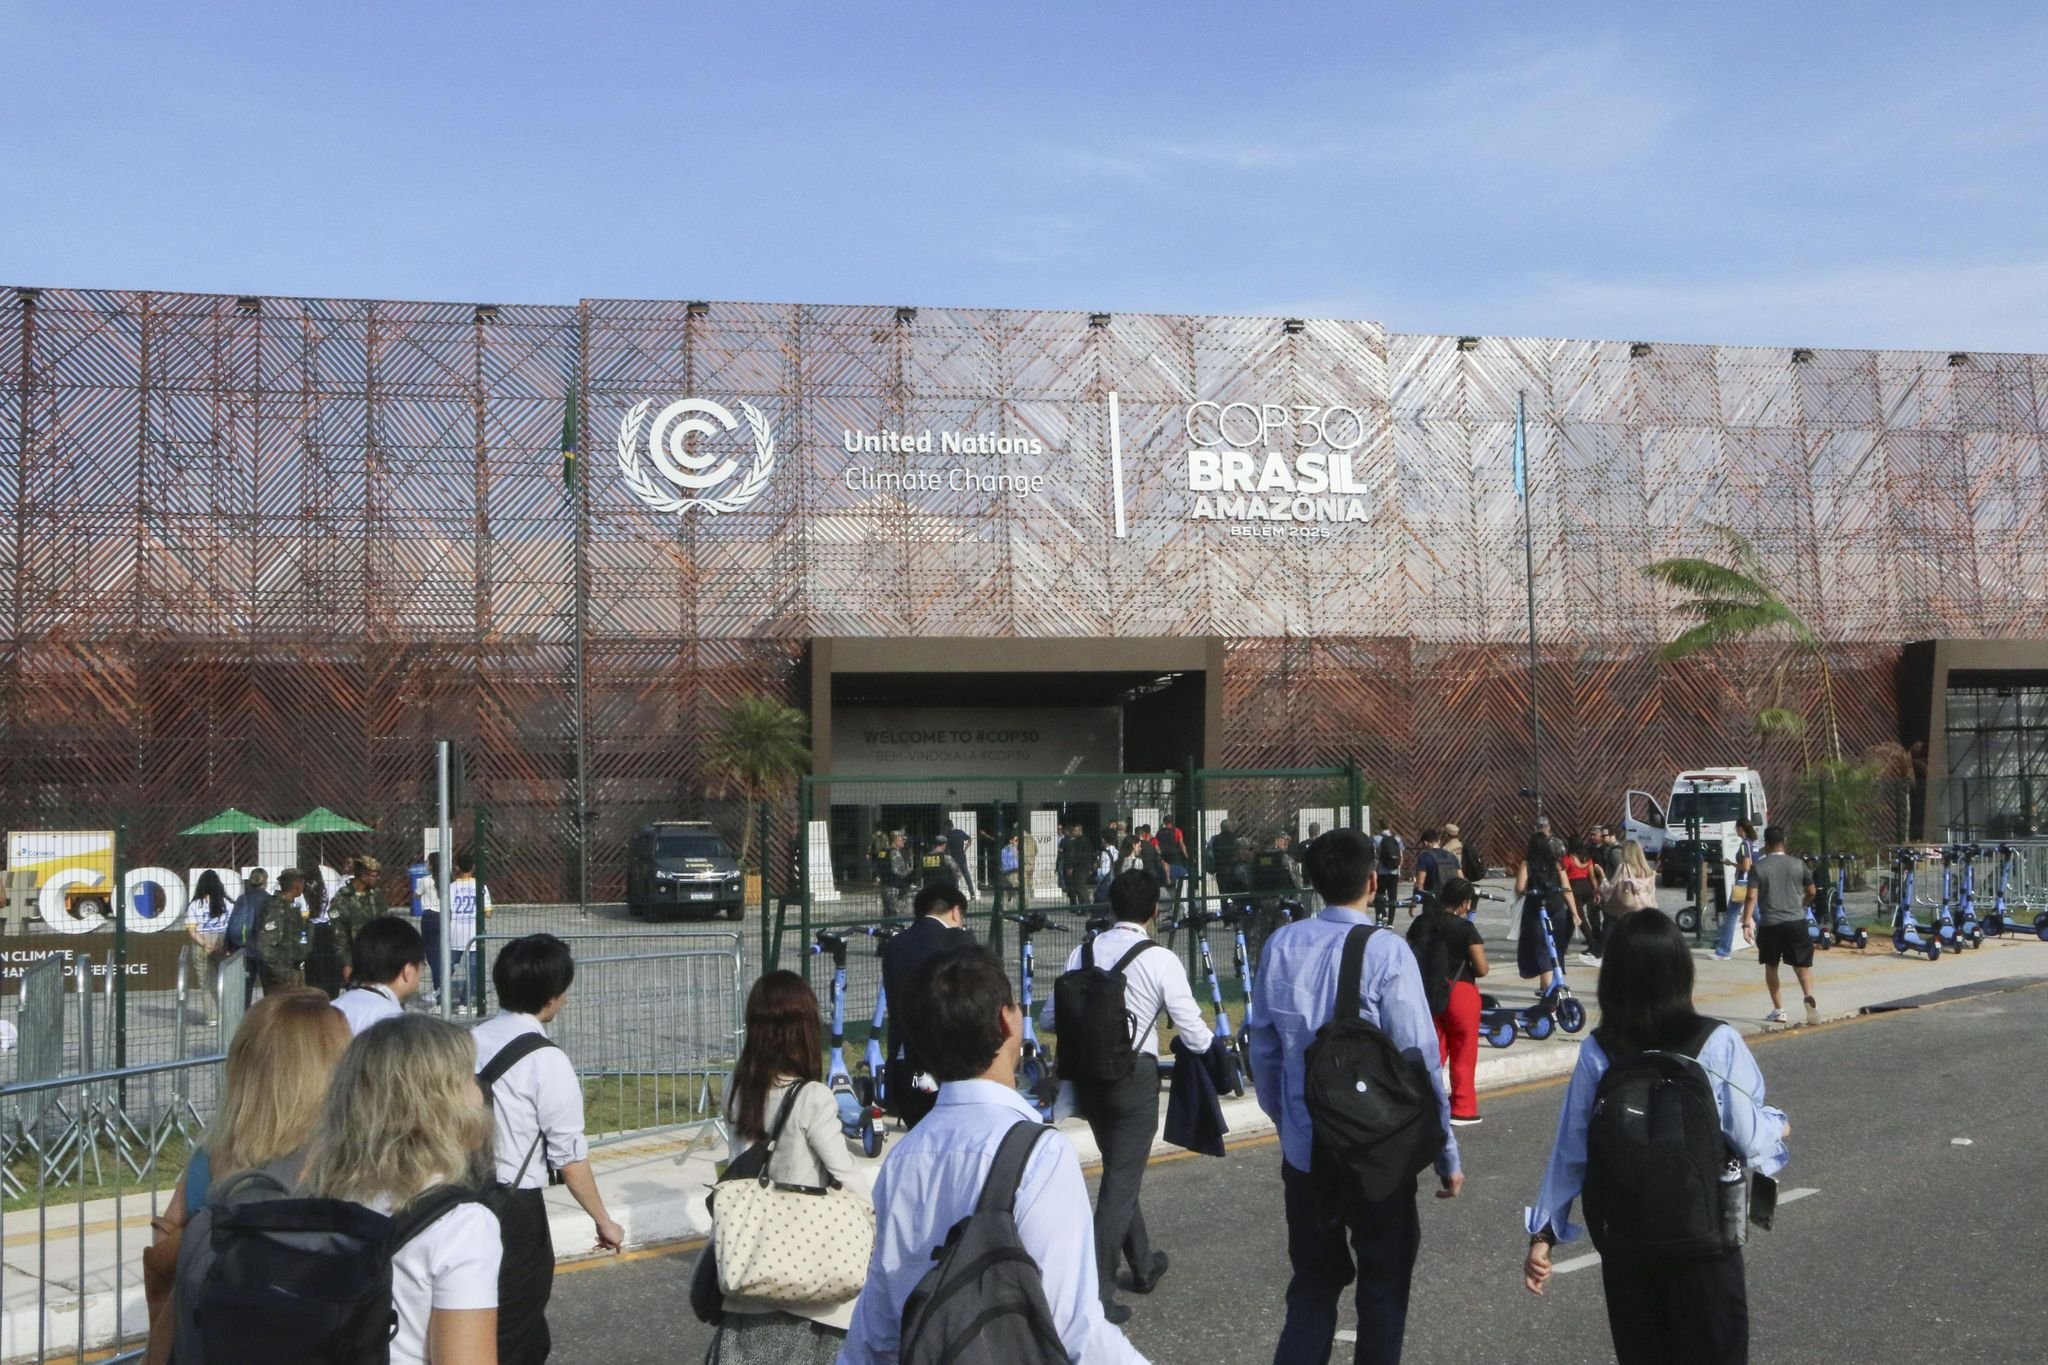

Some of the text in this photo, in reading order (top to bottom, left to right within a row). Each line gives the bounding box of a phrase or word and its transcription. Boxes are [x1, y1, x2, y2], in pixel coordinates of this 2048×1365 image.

[844, 429, 1043, 455] United Nations
[1188, 450, 1368, 494] BRASIL
[845, 467, 1044, 498] Climate Change
[1231, 525, 1330, 538] BELÉM 2025
[864, 729, 1040, 744] WELCOME TO #COP30
[1038, 836, 1052, 844] VIP
